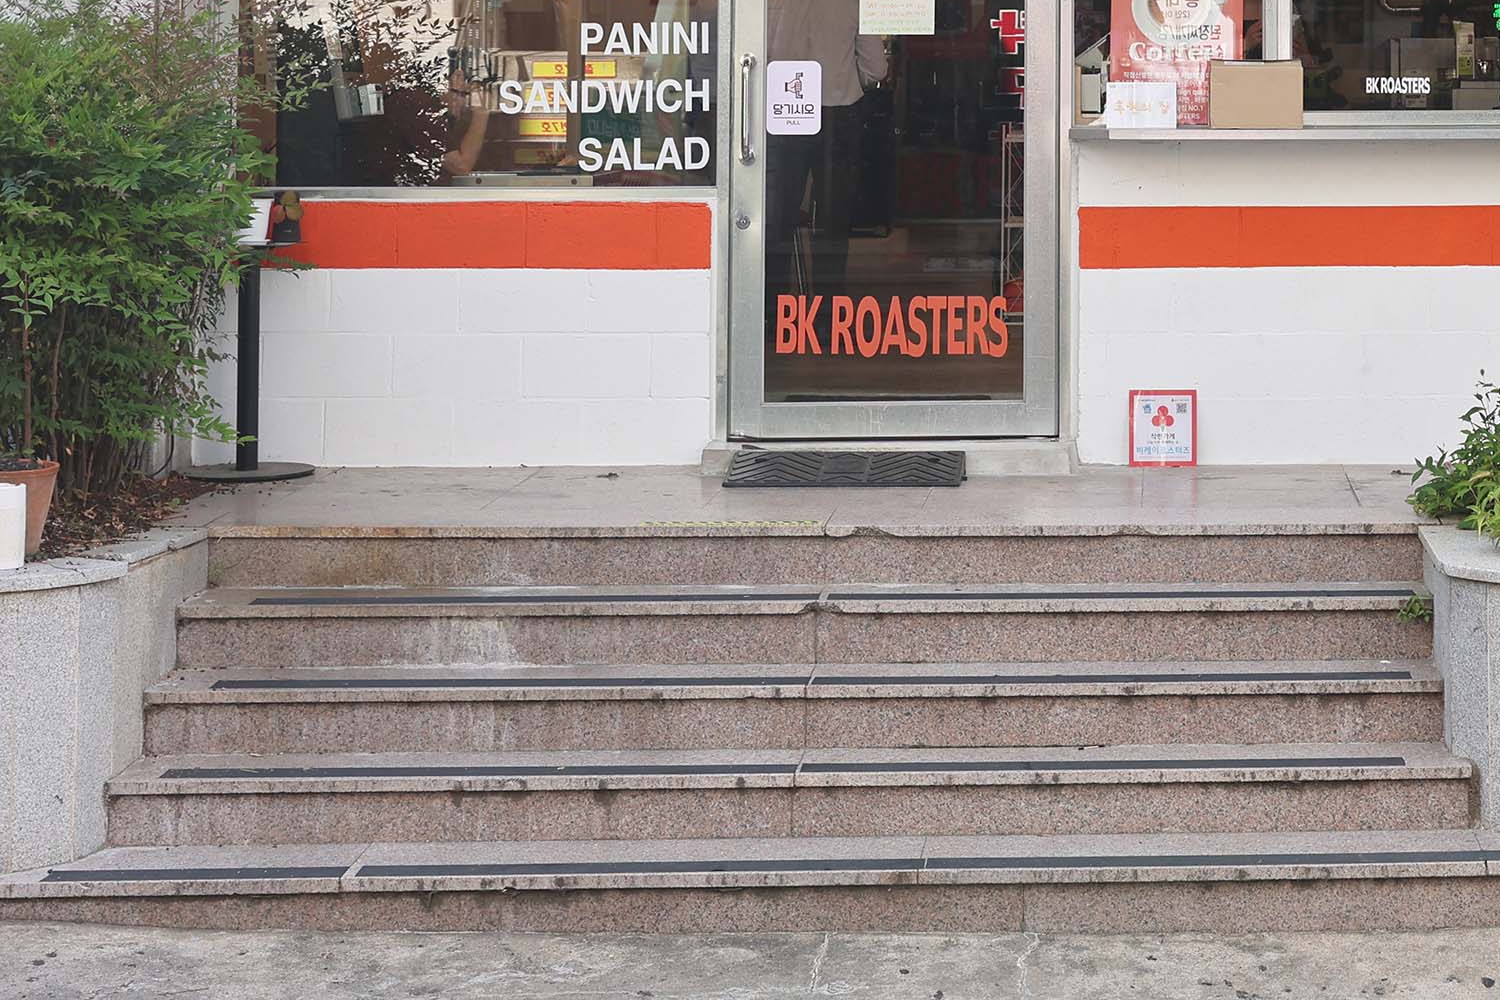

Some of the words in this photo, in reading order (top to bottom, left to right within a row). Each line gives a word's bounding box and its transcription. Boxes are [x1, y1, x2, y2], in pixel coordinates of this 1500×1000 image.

[580, 22, 710, 55] PANINI
[499, 79, 710, 114] SANDWICH
[1365, 76, 1379, 94] BK
[1380, 76, 1431, 94] ROASTERS
[772, 103, 815, 115] 당기시오
[578, 137, 710, 171] SALAD
[776, 294, 824, 355] BK
[831, 294, 1009, 358] ROASTERS
